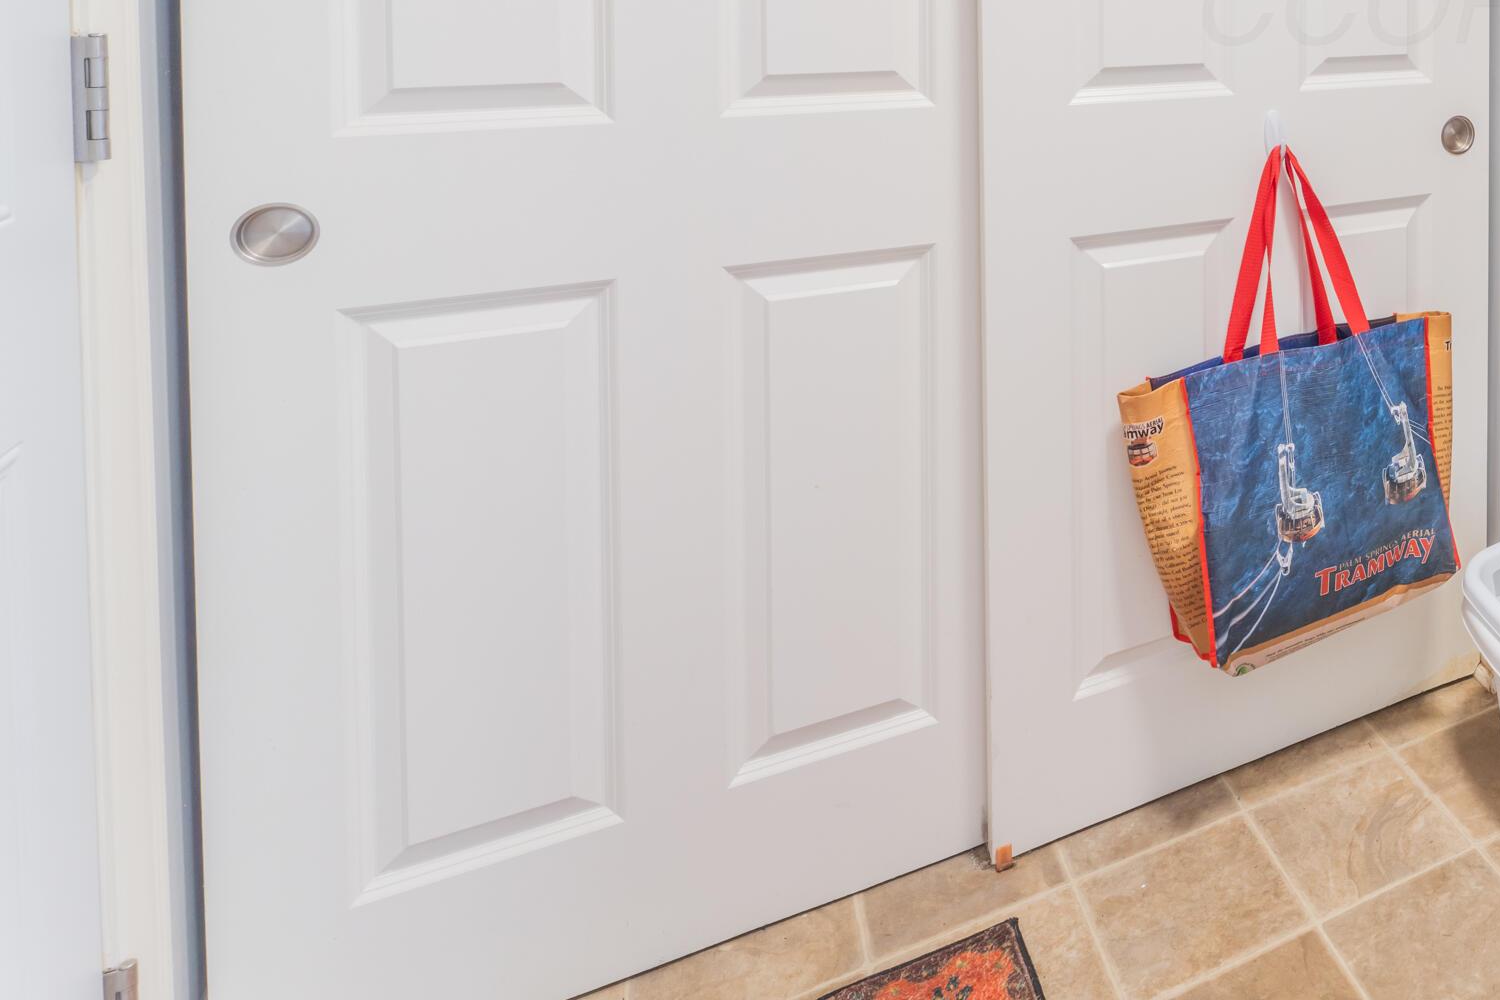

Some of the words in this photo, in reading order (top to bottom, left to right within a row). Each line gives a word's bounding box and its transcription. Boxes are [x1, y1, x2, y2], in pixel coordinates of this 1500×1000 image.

[1315, 535, 1436, 597] TRAMWAY
[1340, 555, 1362, 570] PALM
[1365, 540, 1399, 559] SPRINGS
[1401, 527, 1436, 541] AERIAL
